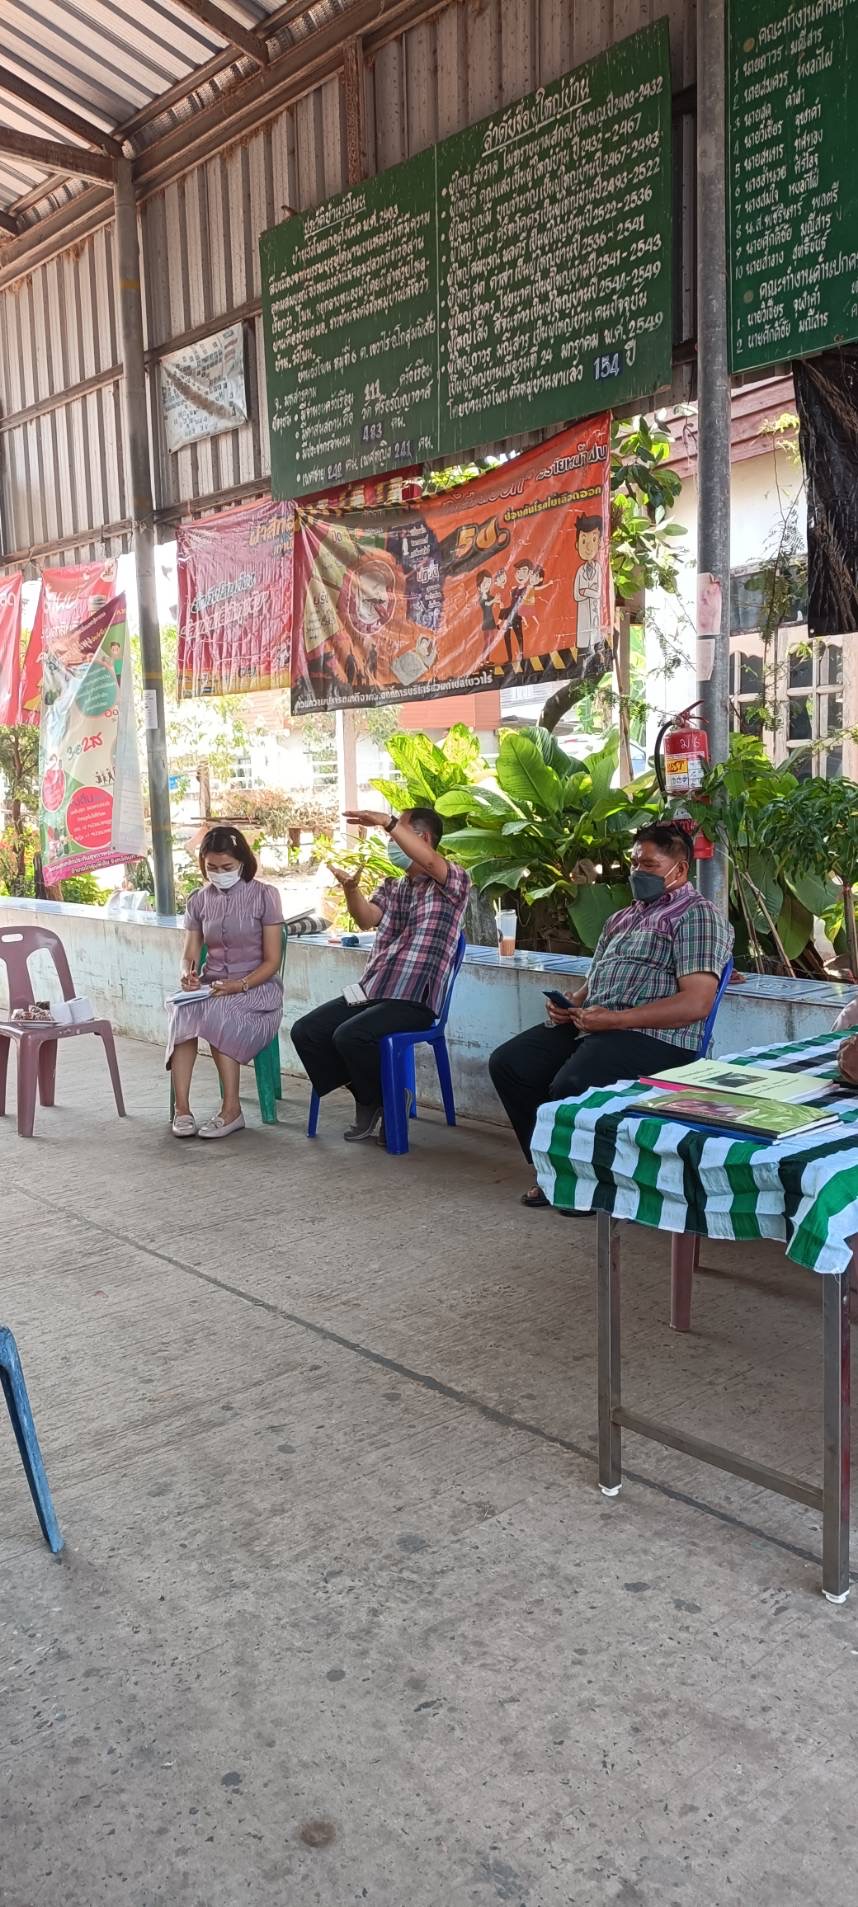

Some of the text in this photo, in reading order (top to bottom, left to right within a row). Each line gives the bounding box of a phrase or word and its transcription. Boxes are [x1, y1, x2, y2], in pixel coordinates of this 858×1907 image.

[628, 311, 663, 337] 2549
[593, 353, 620, 379] 154
[625, 338, 636, 366] ปี
